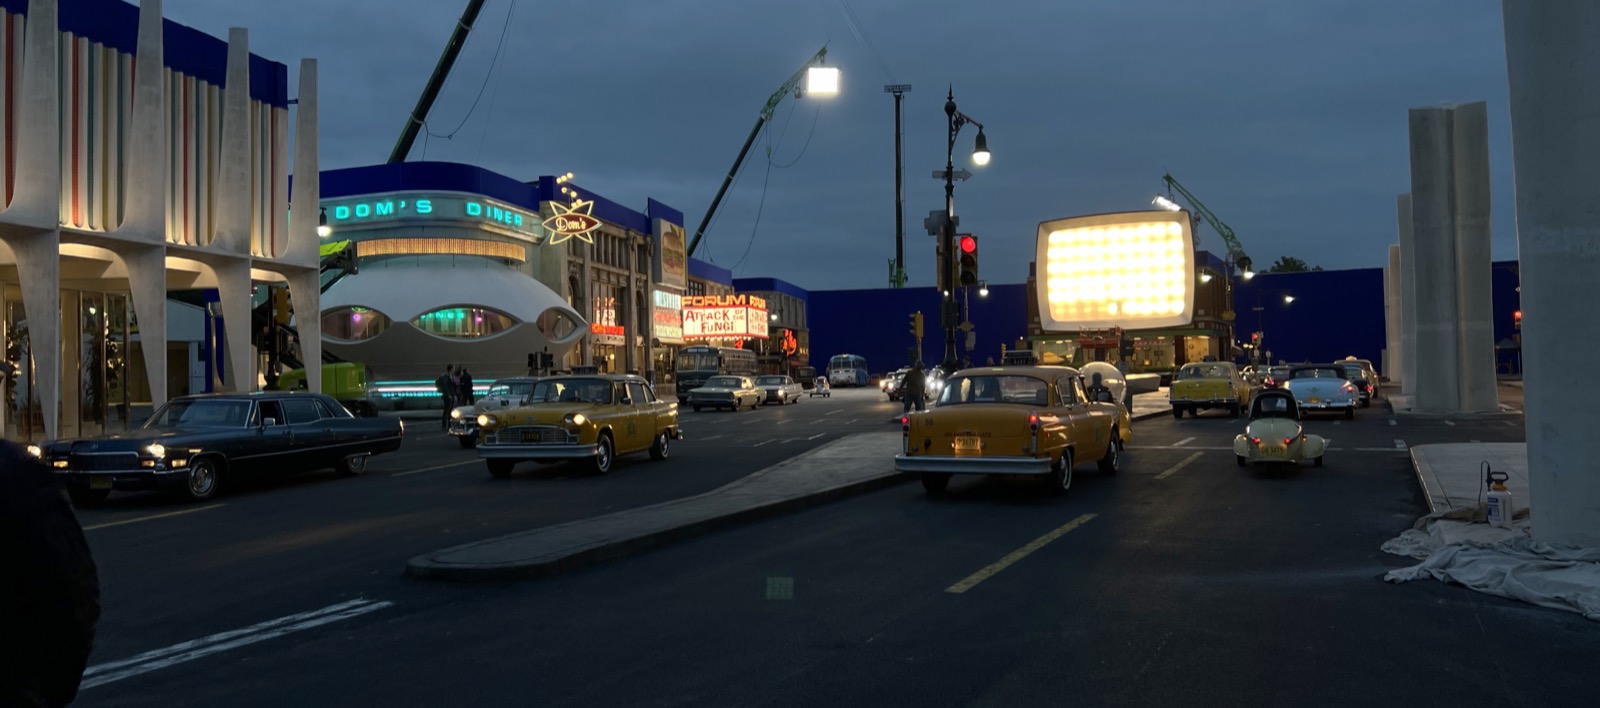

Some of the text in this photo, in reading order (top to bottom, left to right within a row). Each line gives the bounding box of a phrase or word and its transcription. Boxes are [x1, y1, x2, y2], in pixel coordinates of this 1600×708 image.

[335, 200, 523, 226] DOM'S DINER
[555, 216, 587, 231] Dom's
[681, 294, 746, 307] FORUM
[685, 309, 730, 322] ATTACK
